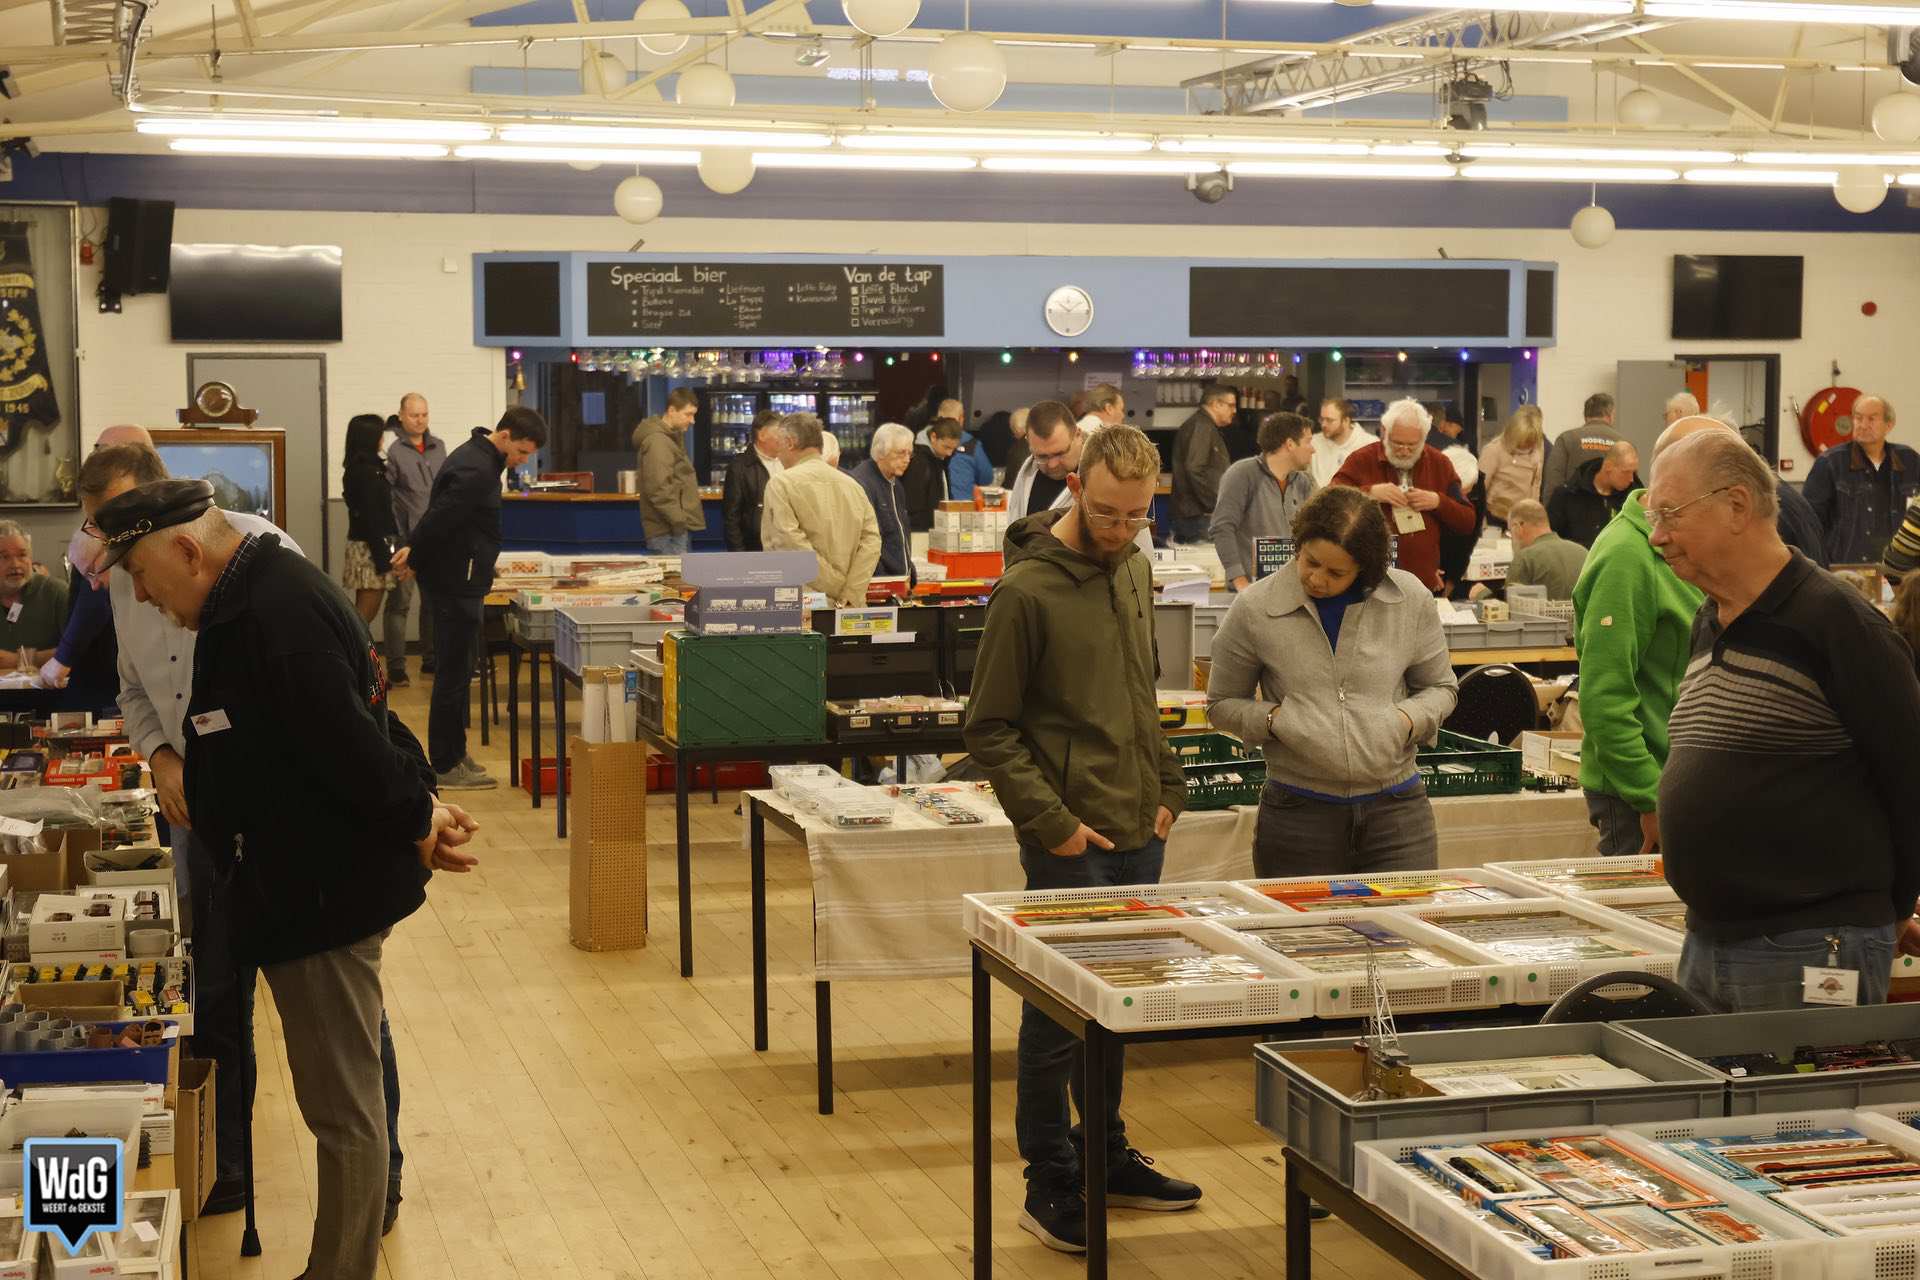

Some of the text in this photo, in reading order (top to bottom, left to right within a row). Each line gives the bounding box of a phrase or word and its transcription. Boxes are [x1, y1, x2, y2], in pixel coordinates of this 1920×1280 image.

[610, 266, 728, 290] Speciaal bier
[844, 266, 933, 286] Van de tap
